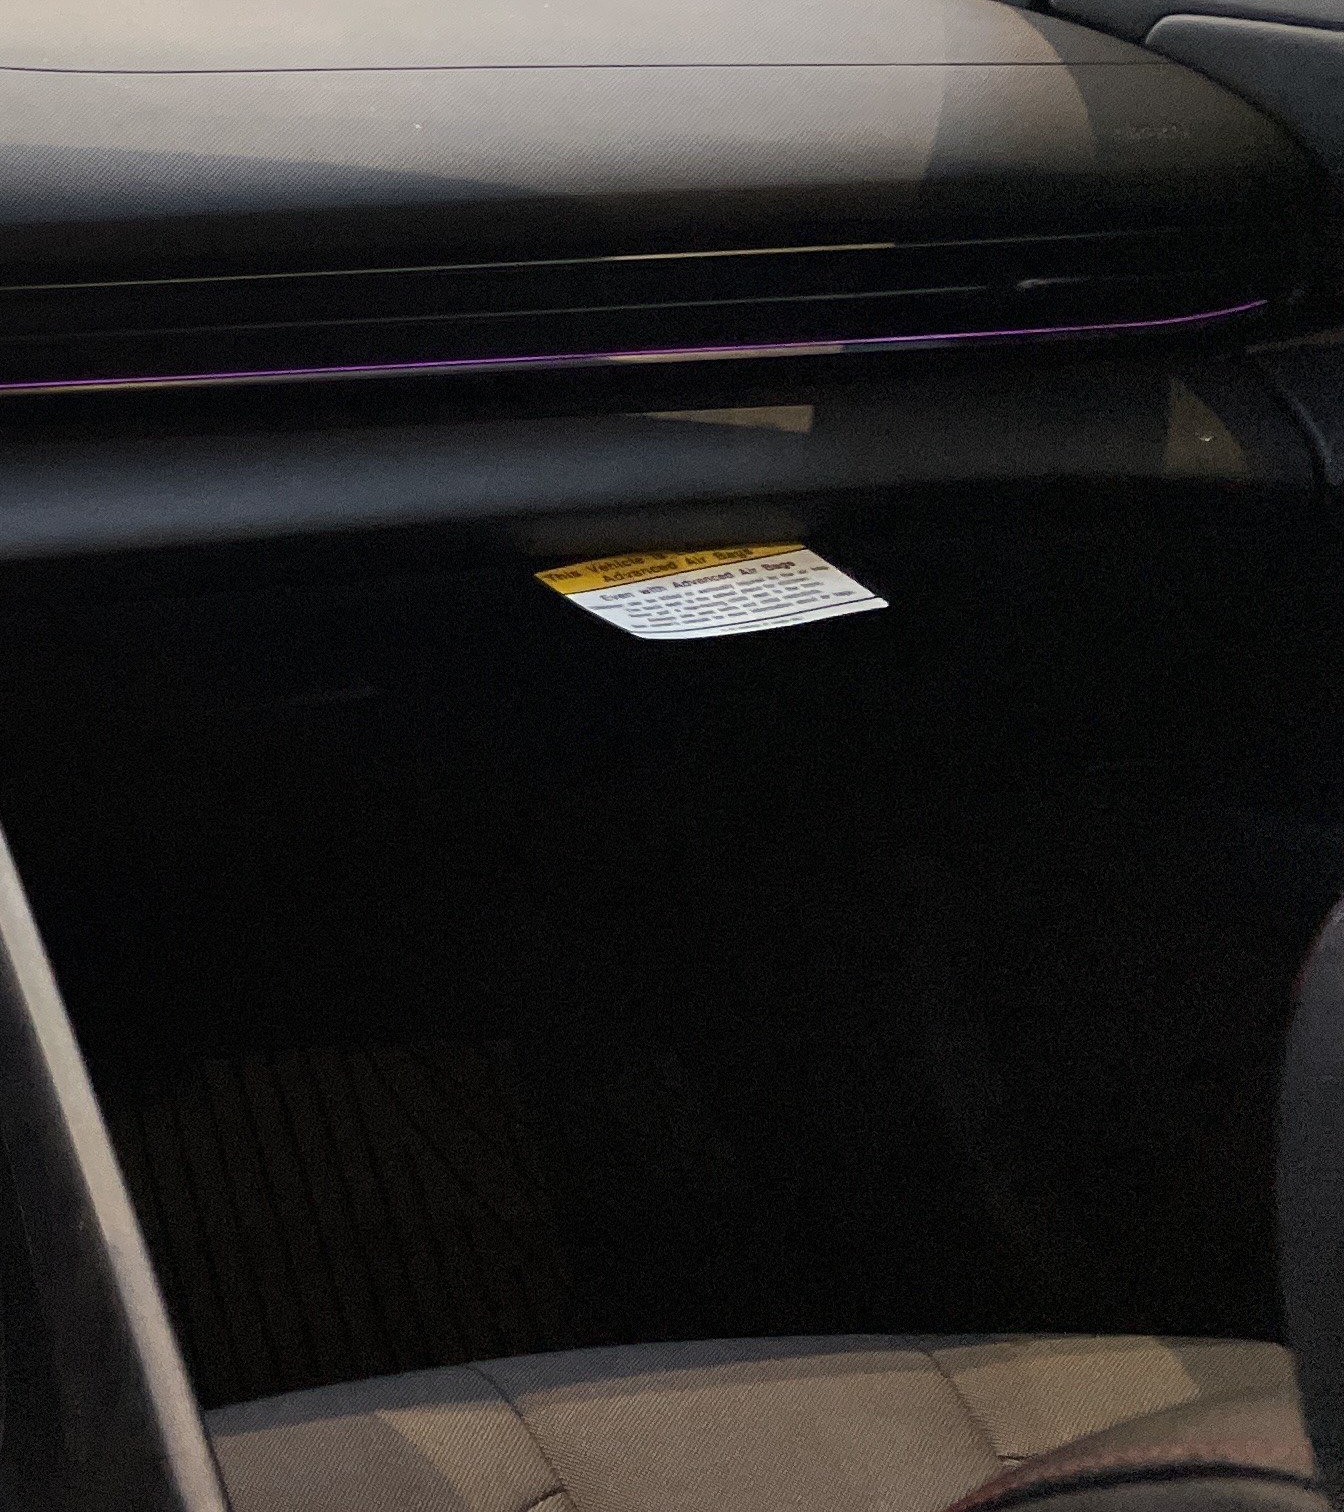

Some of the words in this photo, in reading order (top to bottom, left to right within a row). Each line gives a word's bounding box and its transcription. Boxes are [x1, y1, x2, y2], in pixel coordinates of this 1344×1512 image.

[586, 556, 646, 573] Vehicle
[603, 561, 678, 582] Advanced
[685, 555, 708, 566] Air
[673, 572, 735, 588] Advanced
[739, 567, 757, 576] Air
[761, 561, 796, 572] Bags
